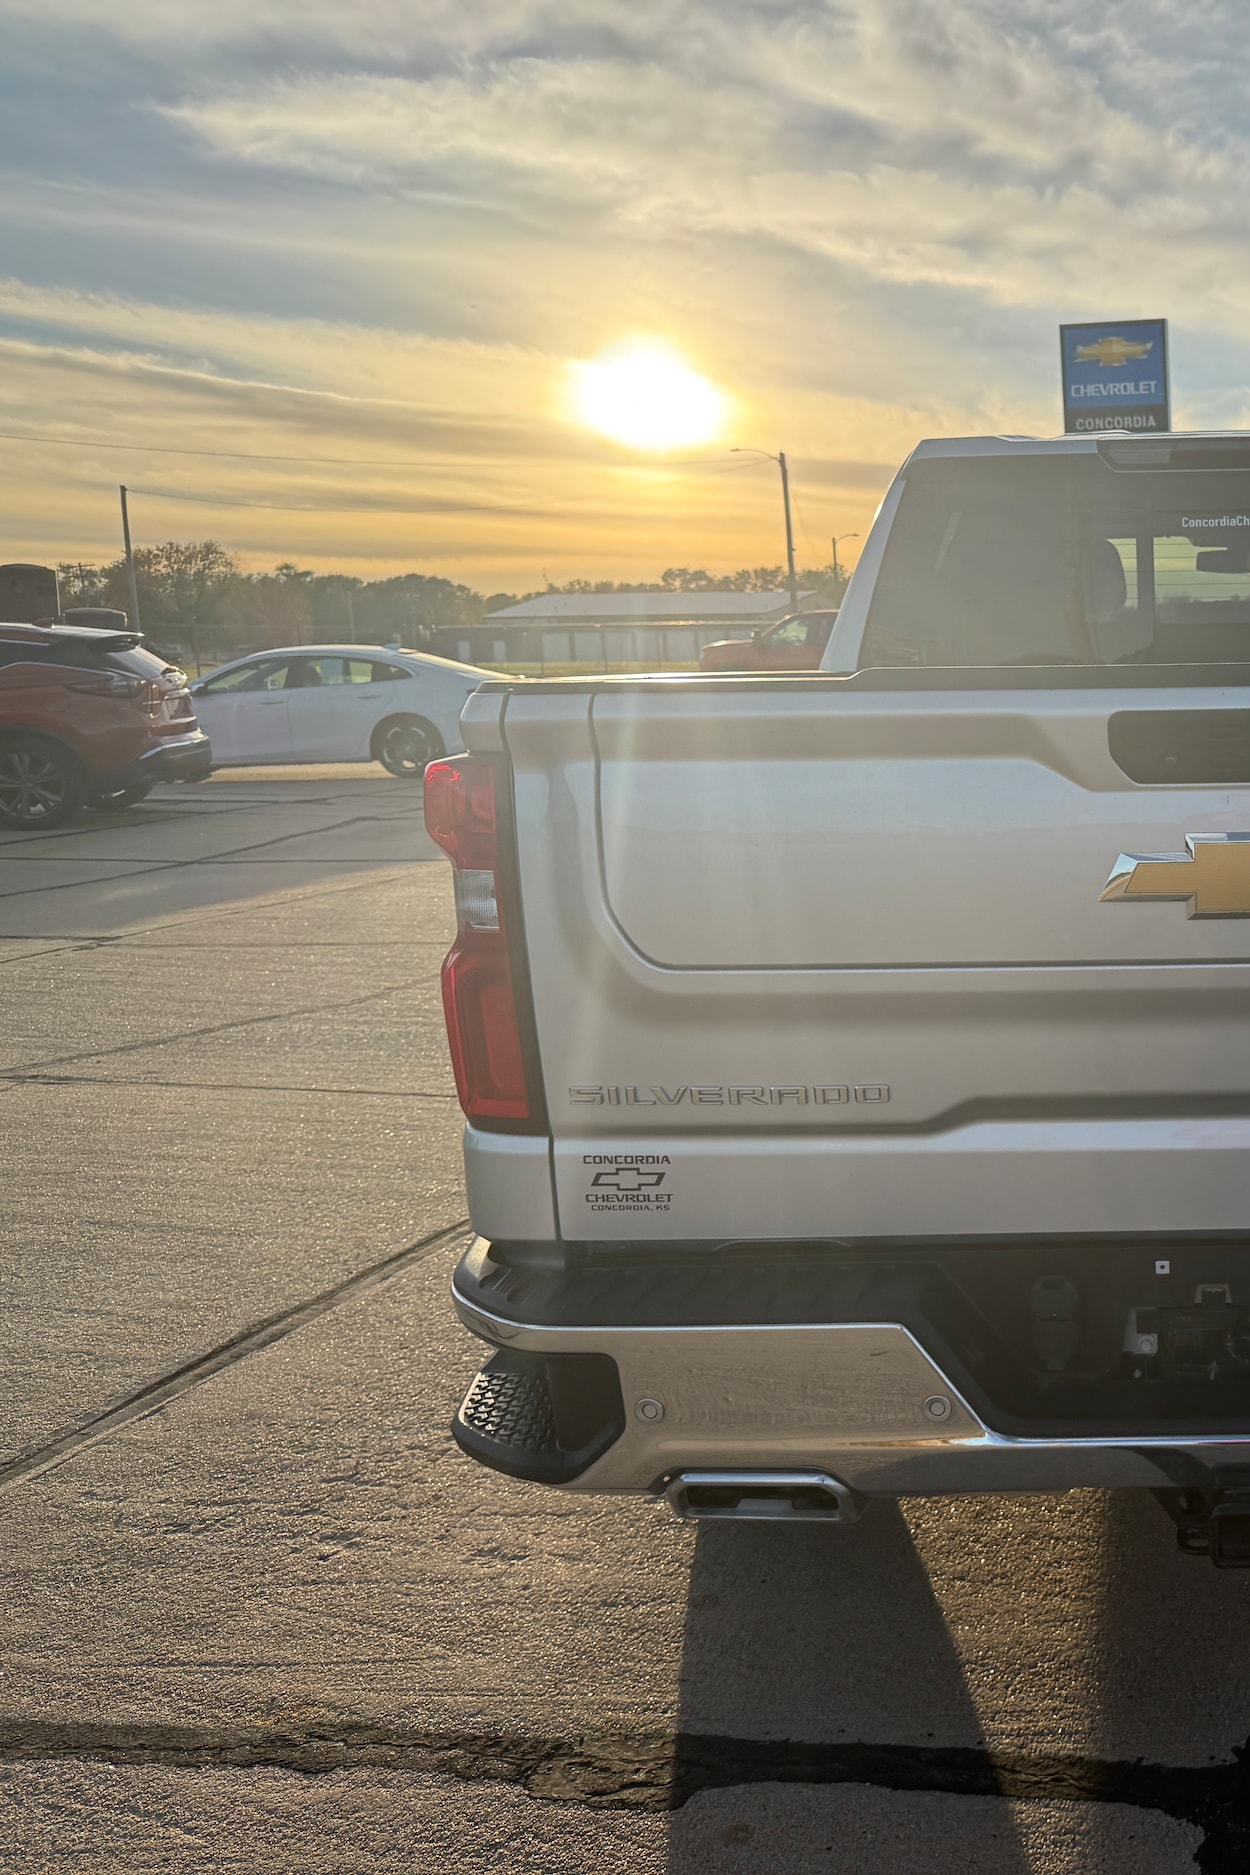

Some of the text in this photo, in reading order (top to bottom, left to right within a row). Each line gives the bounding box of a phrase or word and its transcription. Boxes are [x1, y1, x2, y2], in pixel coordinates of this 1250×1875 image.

[1071, 381, 1157, 397] CHEVROLET
[1076, 415, 1156, 430] CONCORDIA
[568, 1083, 891, 1106] SILVERADO
[583, 1155, 671, 1164] CONCORDIA
[585, 1193, 674, 1203] CHEVROLET
